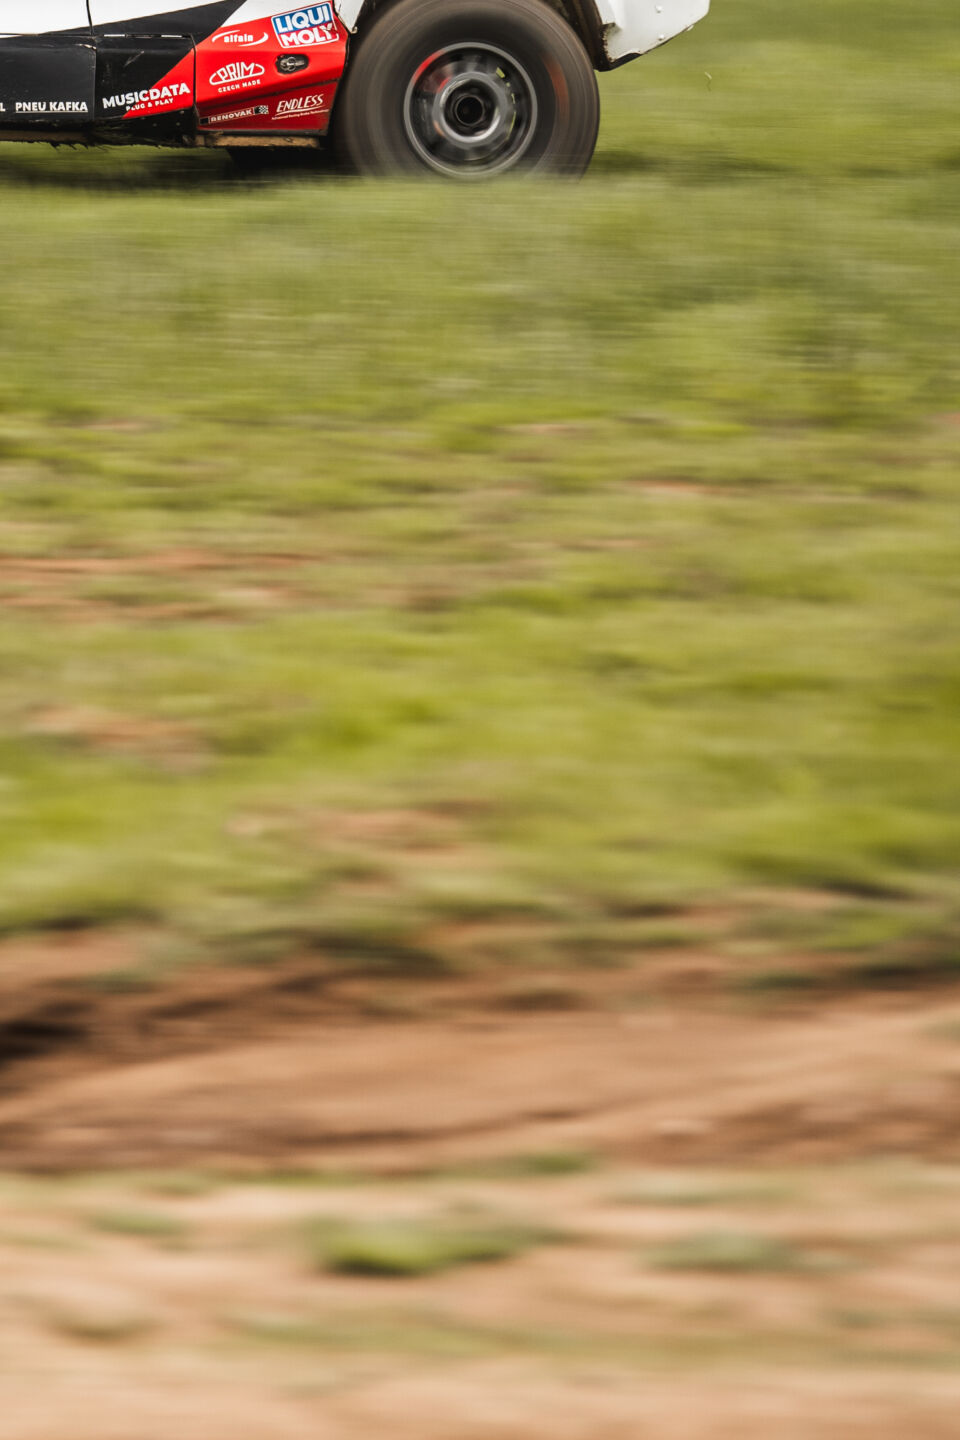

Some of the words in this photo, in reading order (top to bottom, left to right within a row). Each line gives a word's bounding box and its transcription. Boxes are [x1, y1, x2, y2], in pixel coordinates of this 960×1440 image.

[273, 4, 332, 33] LIQUI
[281, 24, 334, 46] MOLY
[216, 61, 256, 82] PRIM
[102, 83, 191, 109] MUSICDATA
[218, 84, 240, 93] CZECH
[242, 79, 261, 88] MADE
[15, 102, 46, 111] PNEU
[49, 102, 88, 111] KAFKA
[155, 97, 175, 107] PLAY
[276, 93, 324, 113] ENDLESS
[210, 109, 253, 123] RENOVAK
